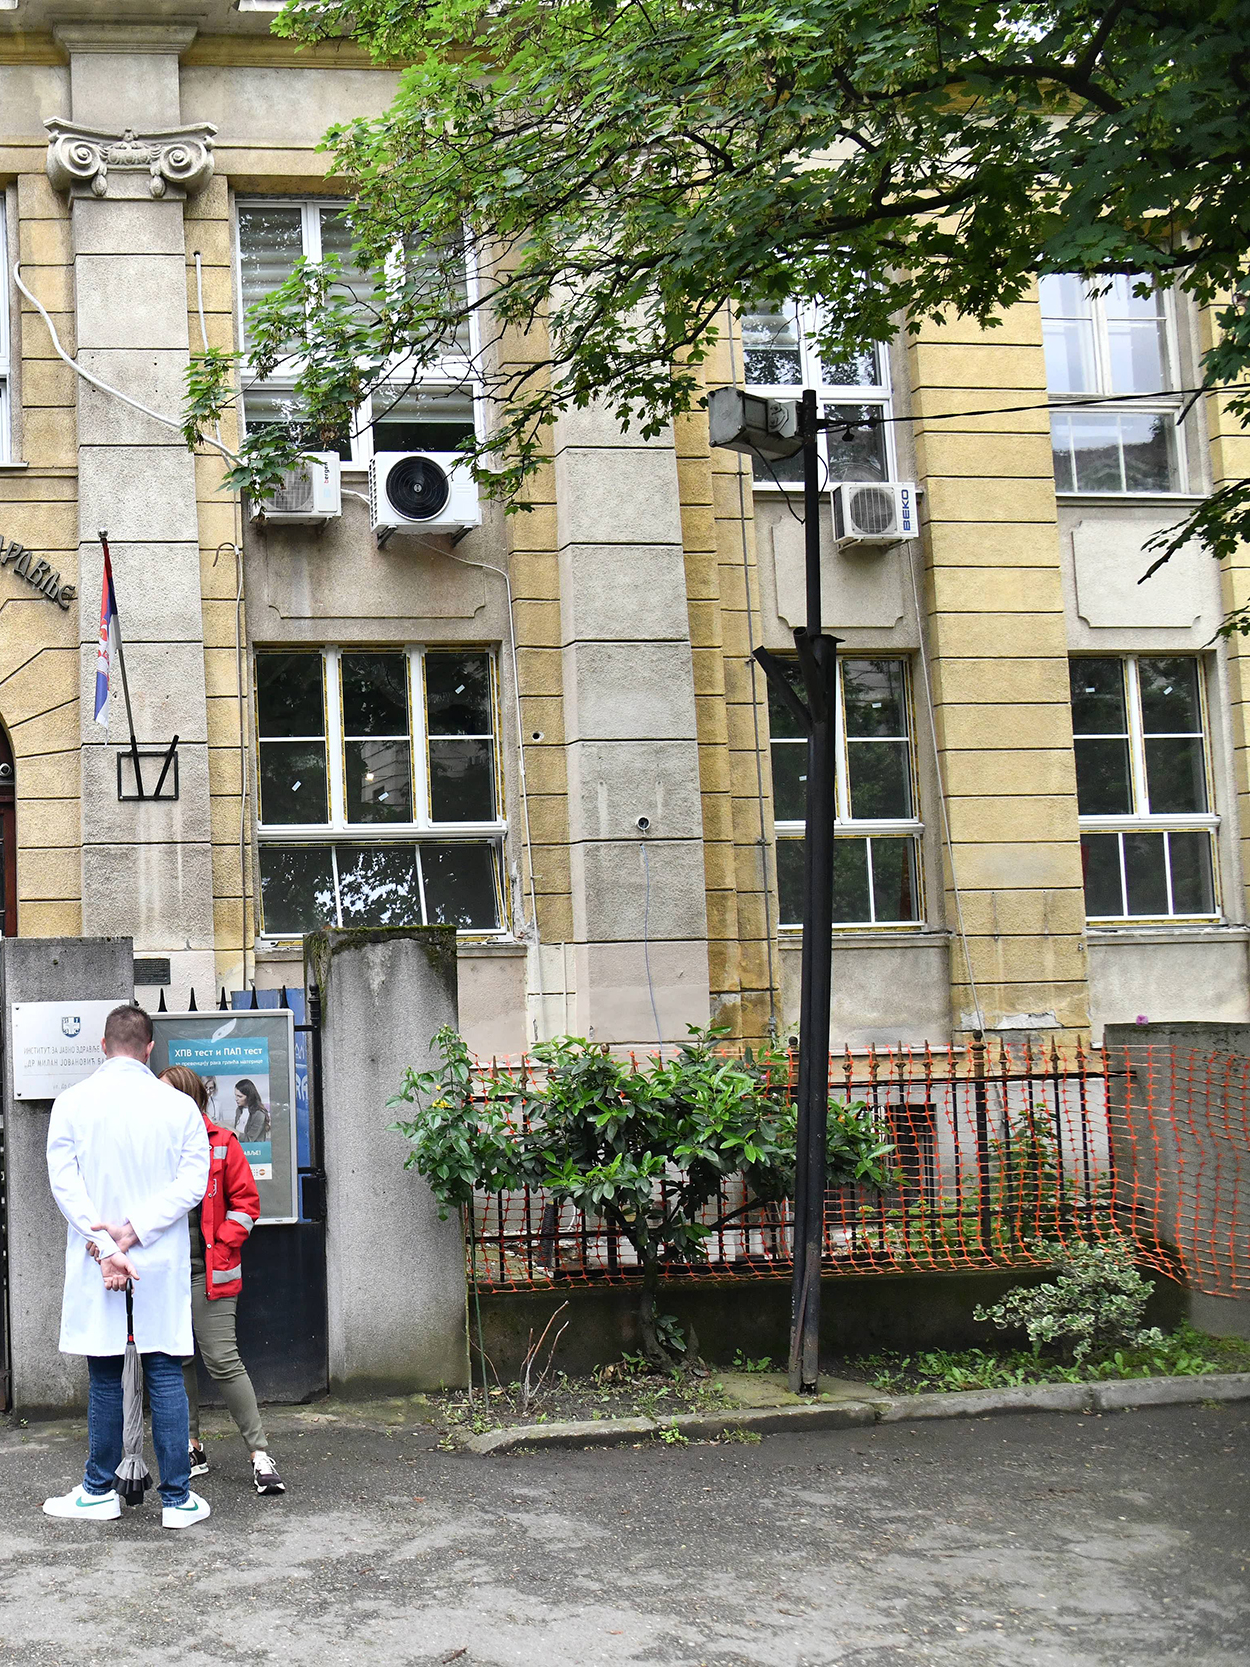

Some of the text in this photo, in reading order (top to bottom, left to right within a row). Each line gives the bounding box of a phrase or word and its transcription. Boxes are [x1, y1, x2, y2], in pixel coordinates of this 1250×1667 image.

[901, 489, 910, 530] BEKO
[59, 1046, 76, 1054] ЈАВНО
[76, 1045, 100, 1054] ЗДРАВЉЕ
[175, 1049, 192, 1057] ХПВ
[60, 1058, 96, 1066] ЈОВАНОВИЋ
